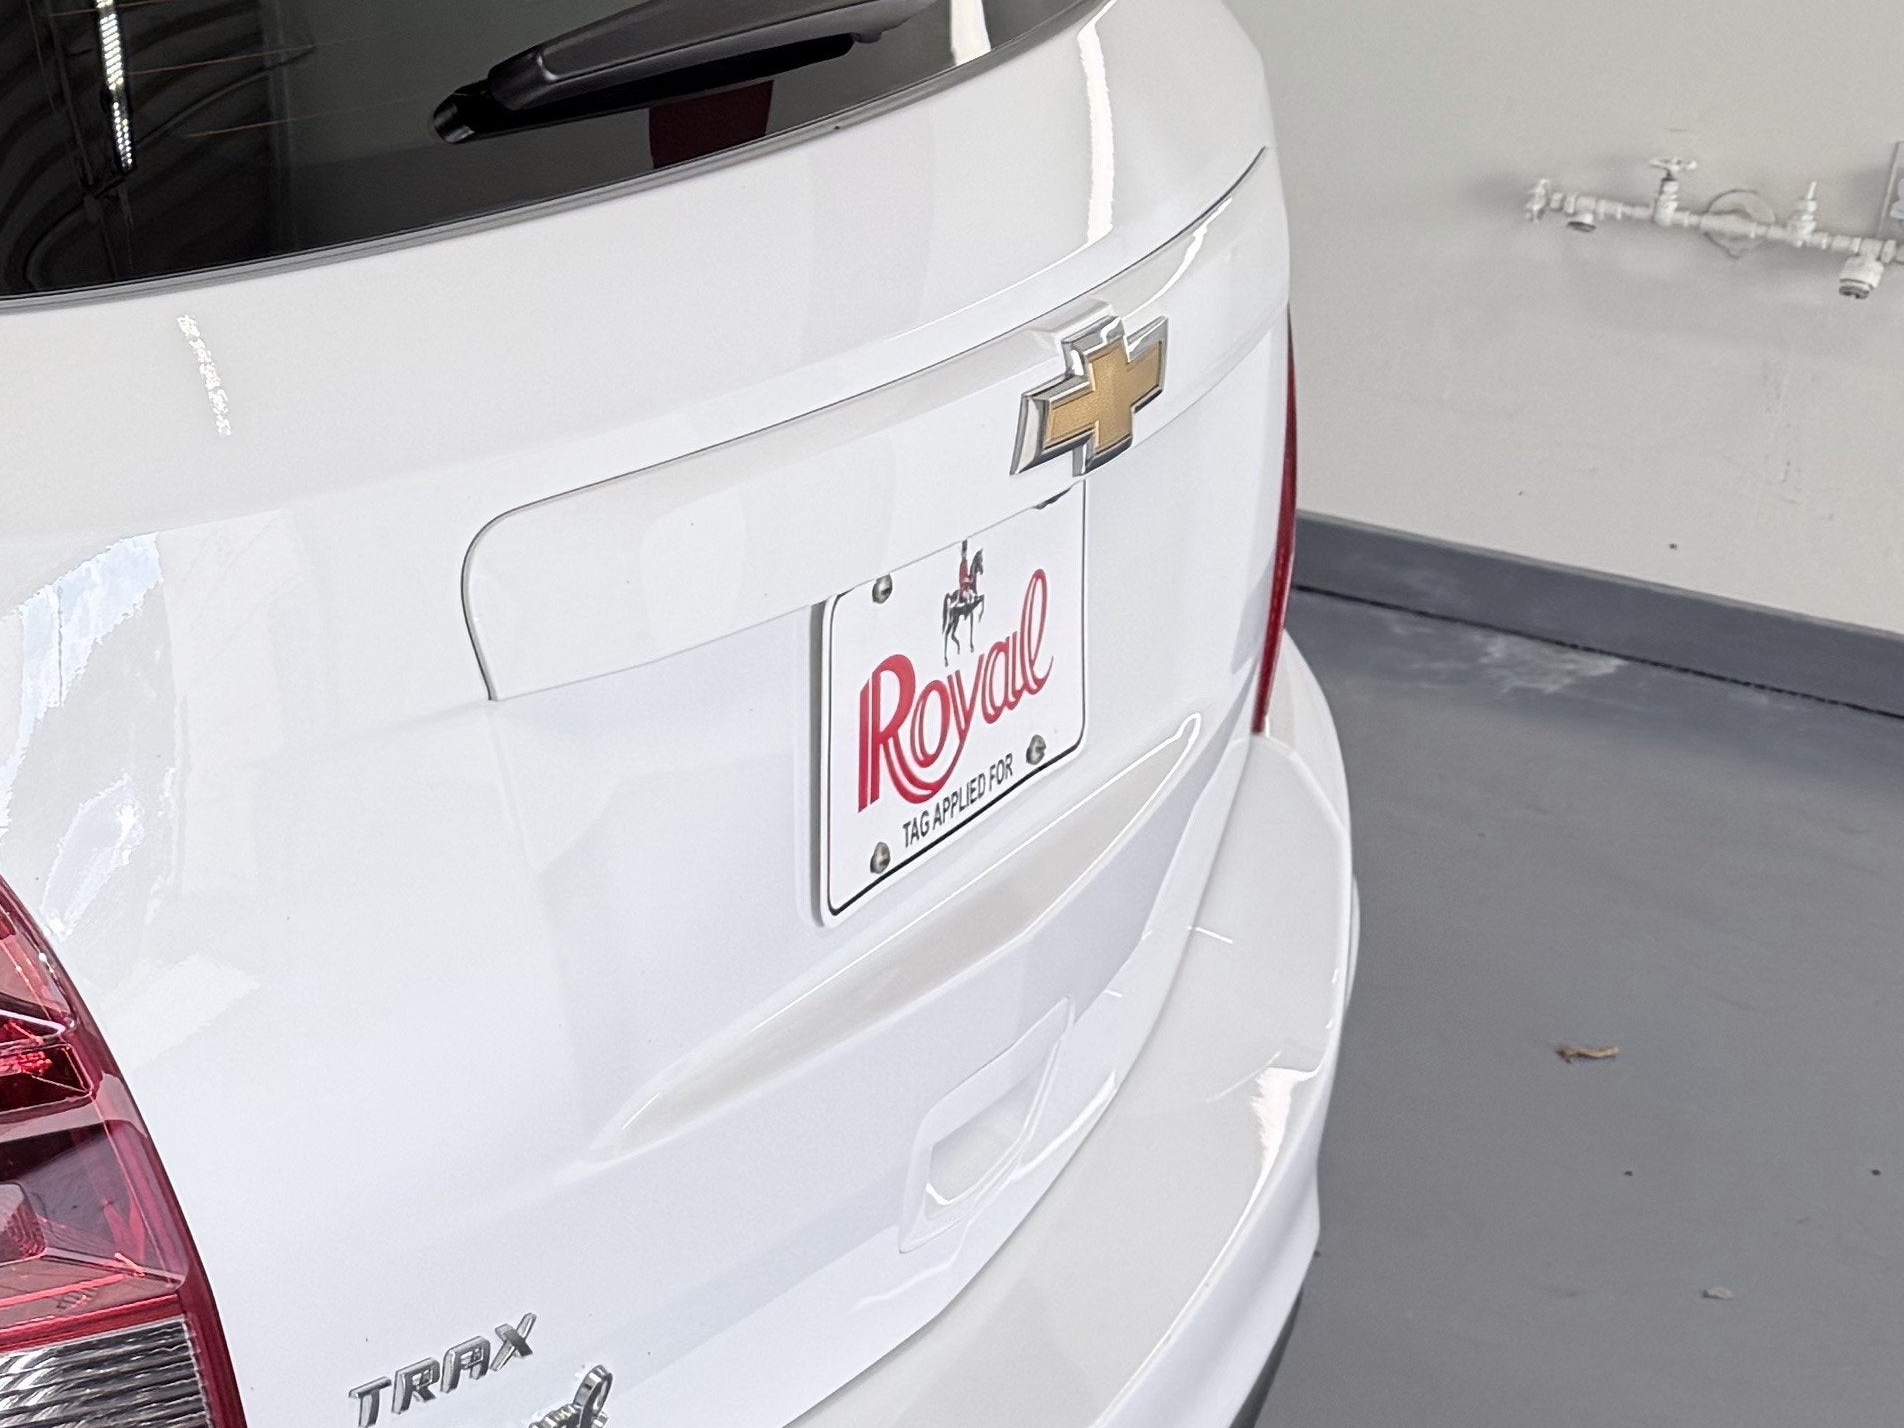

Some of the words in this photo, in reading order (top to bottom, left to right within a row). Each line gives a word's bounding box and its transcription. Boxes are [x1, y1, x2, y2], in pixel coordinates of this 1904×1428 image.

[857, 567, 1055, 813] Royal
[901, 809, 930, 848] TAG
[932, 772, 986, 831] APPLIED
[989, 752, 1013, 792] FOR
[348, 1312, 538, 1428] TRAX
